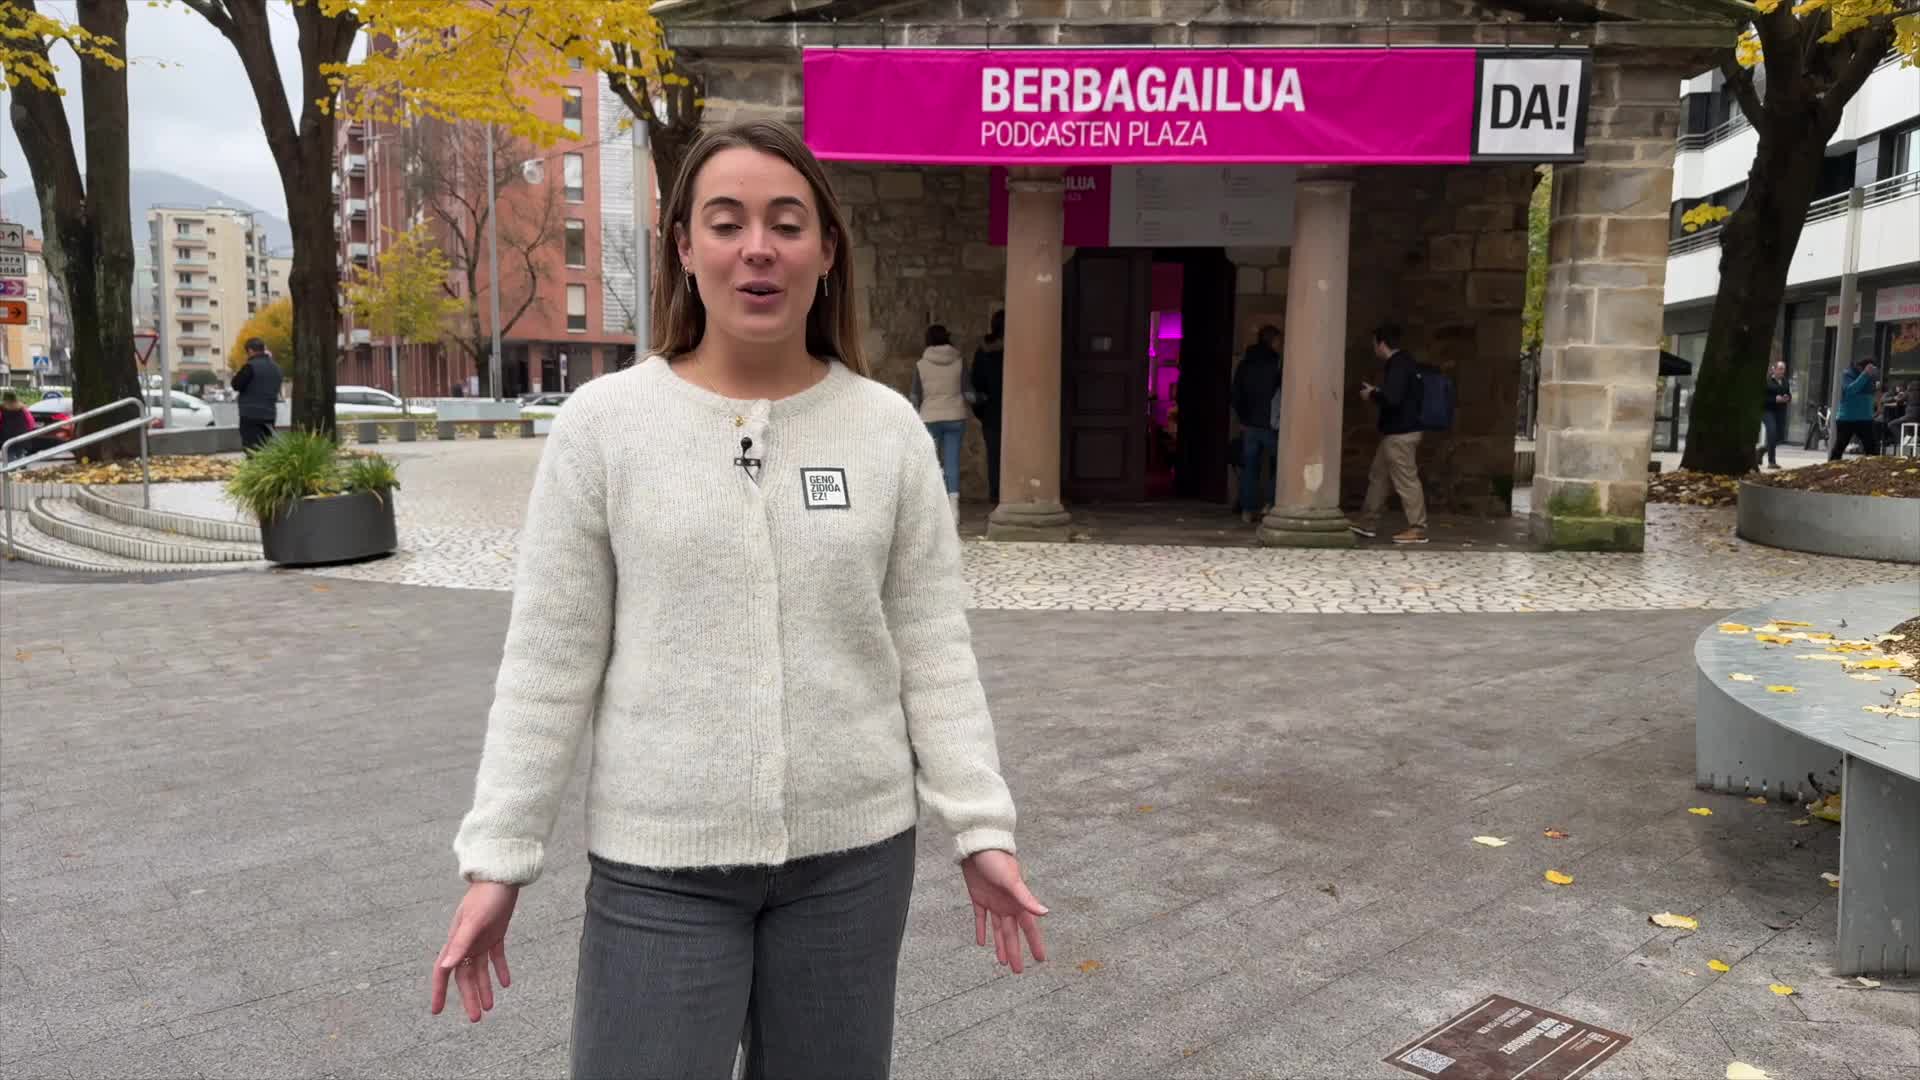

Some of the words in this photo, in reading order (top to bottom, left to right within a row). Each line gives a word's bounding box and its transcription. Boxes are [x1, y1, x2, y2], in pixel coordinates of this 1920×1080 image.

[981, 67, 1306, 112] BERBAGAILUA
[1490, 84, 1569, 130] DA!
[981, 120, 1121, 147] PODCASTEN
[1127, 120, 1208, 147] PLAZA
[809, 475, 834, 484] GENO
[811, 484, 841, 492] ZIDIOA
